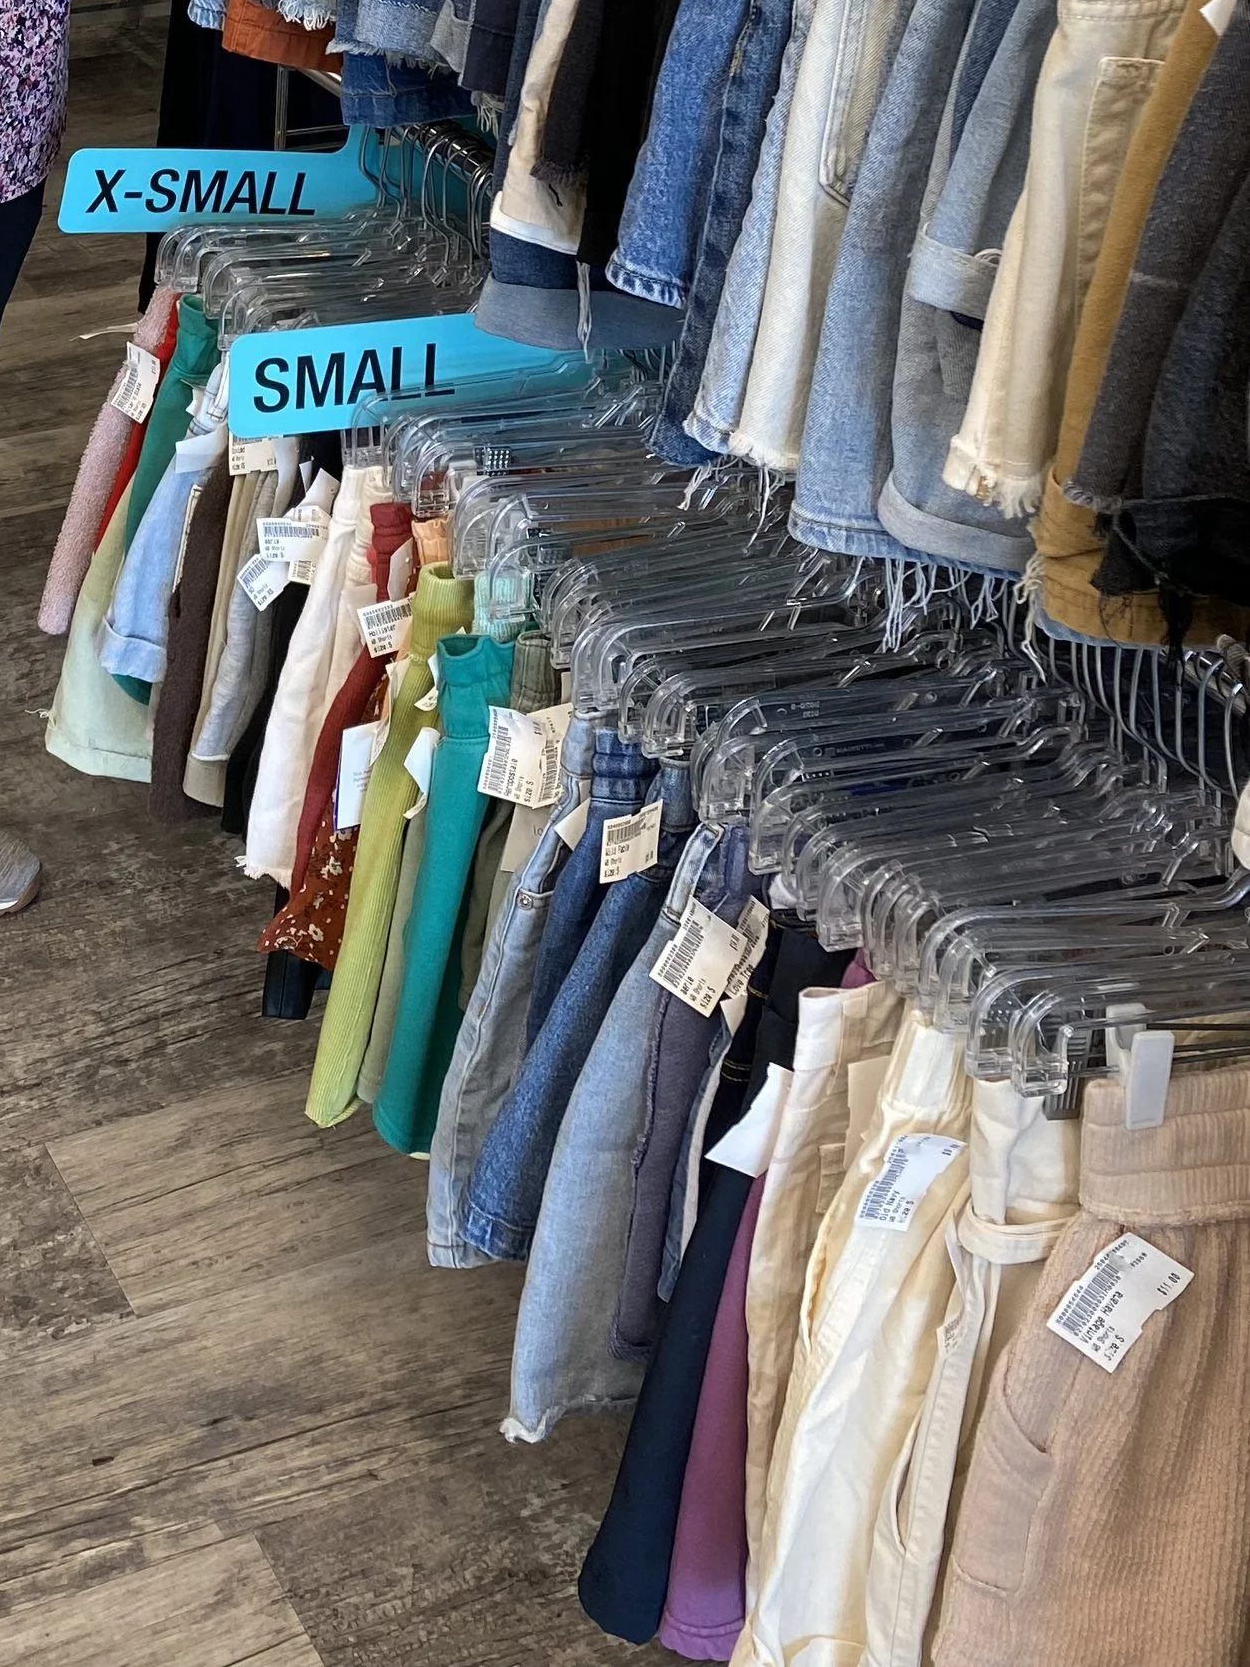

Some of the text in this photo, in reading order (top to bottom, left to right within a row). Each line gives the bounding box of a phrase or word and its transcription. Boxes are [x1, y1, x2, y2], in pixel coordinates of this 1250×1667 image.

[85, 168, 316, 216] X-SMALL
[253, 343, 456, 414] SMALL
[503, 758, 519, 798] Aeropostale
[730, 963, 755, 996] Love Tree
[878, 1190, 901, 1221] Old Navy
[1156, 1272, 1181, 1296] $11.00
[1079, 1290, 1124, 1344] Vintage Havana
[1096, 1325, 1116, 1345] Shorts
